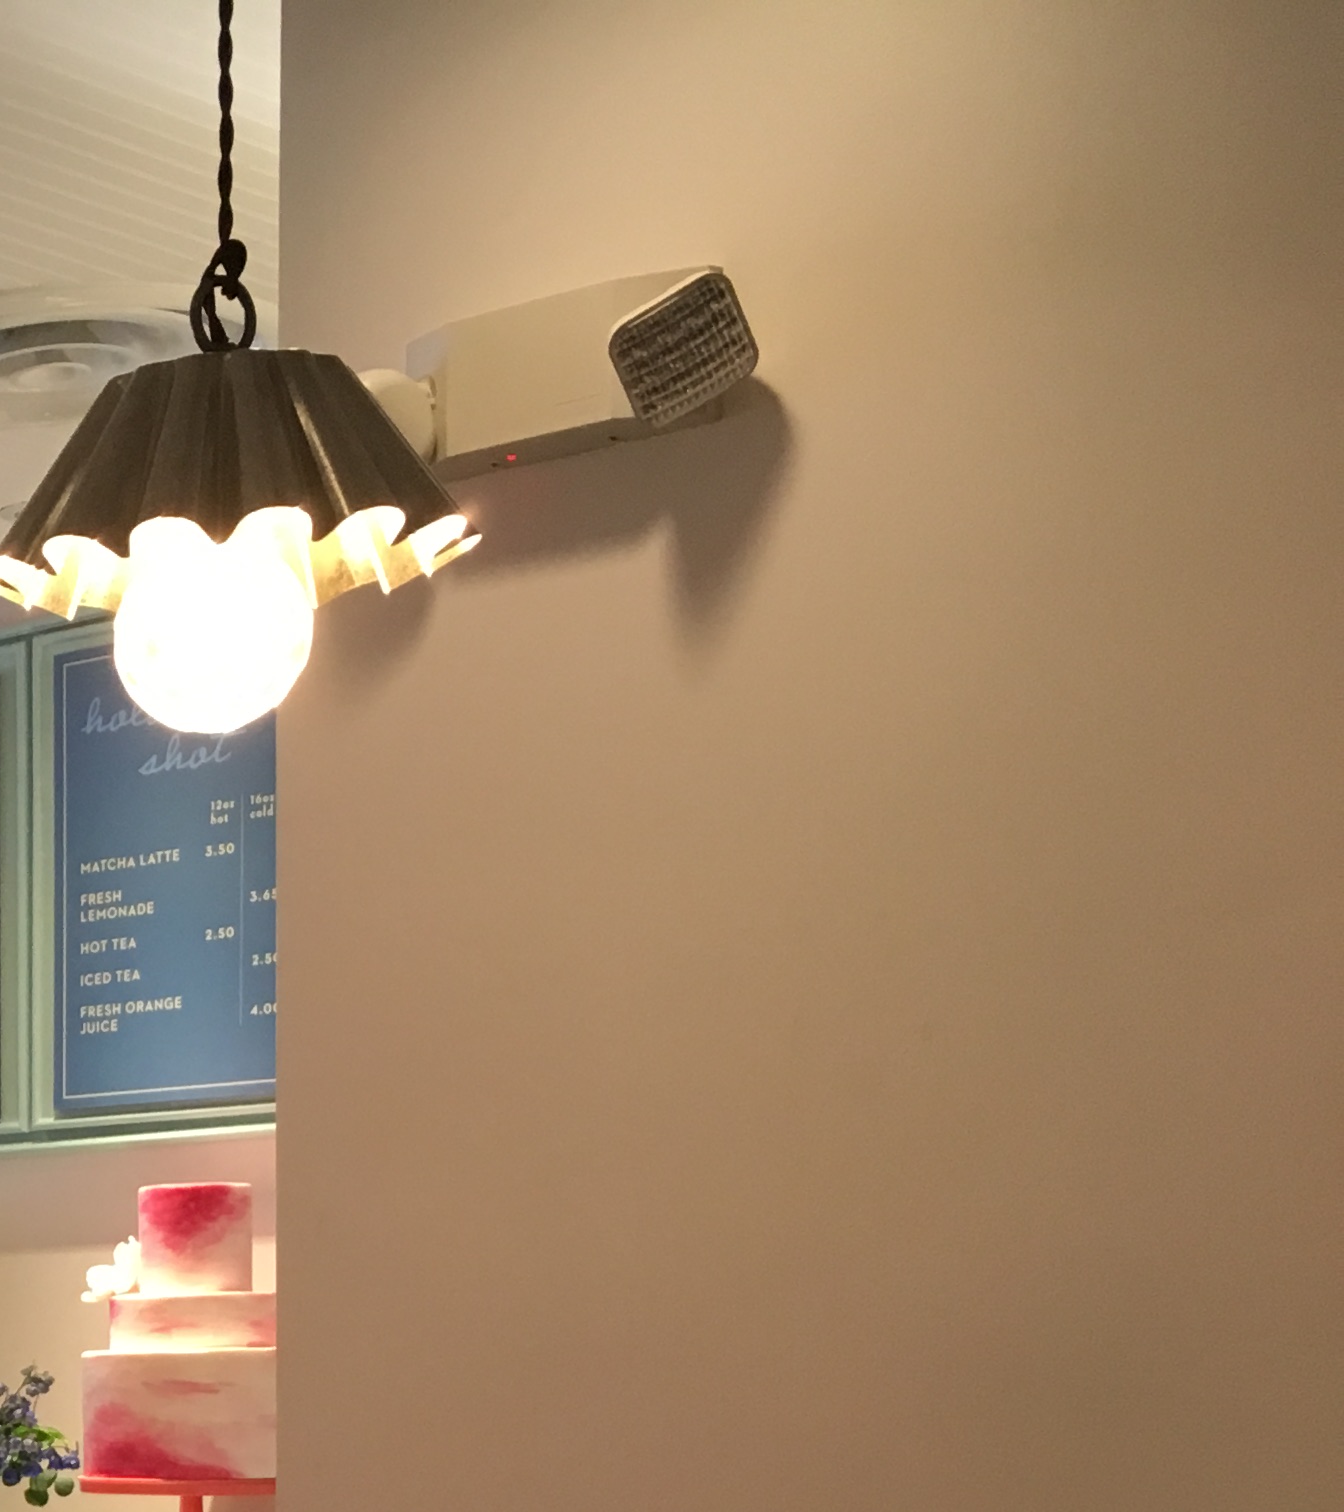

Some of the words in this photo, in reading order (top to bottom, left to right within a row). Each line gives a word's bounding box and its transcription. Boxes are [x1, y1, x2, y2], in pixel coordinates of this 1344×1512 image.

[138, 730, 247, 775] shot
[210, 800, 235, 811] 12oz
[250, 793, 275, 805] 16oz
[210, 812, 229, 825] hot
[249, 804, 275, 819] cold
[80, 857, 136, 875] MATCHA
[139, 849, 180, 866] LATTE
[205, 842, 235, 858] 3.50
[80, 890, 122, 907] FRESH
[80, 901, 155, 923] LEMONADE
[80, 939, 108, 955] HOT
[111, 937, 137, 951] TEA
[205, 926, 235, 941] 2.50
[80, 971, 112, 987] ICED
[116, 969, 141, 983] TEA
[80, 1003, 122, 1019] FRESH
[125, 996, 182, 1014] ORANGE
[80, 1019, 119, 1035] JUICE
